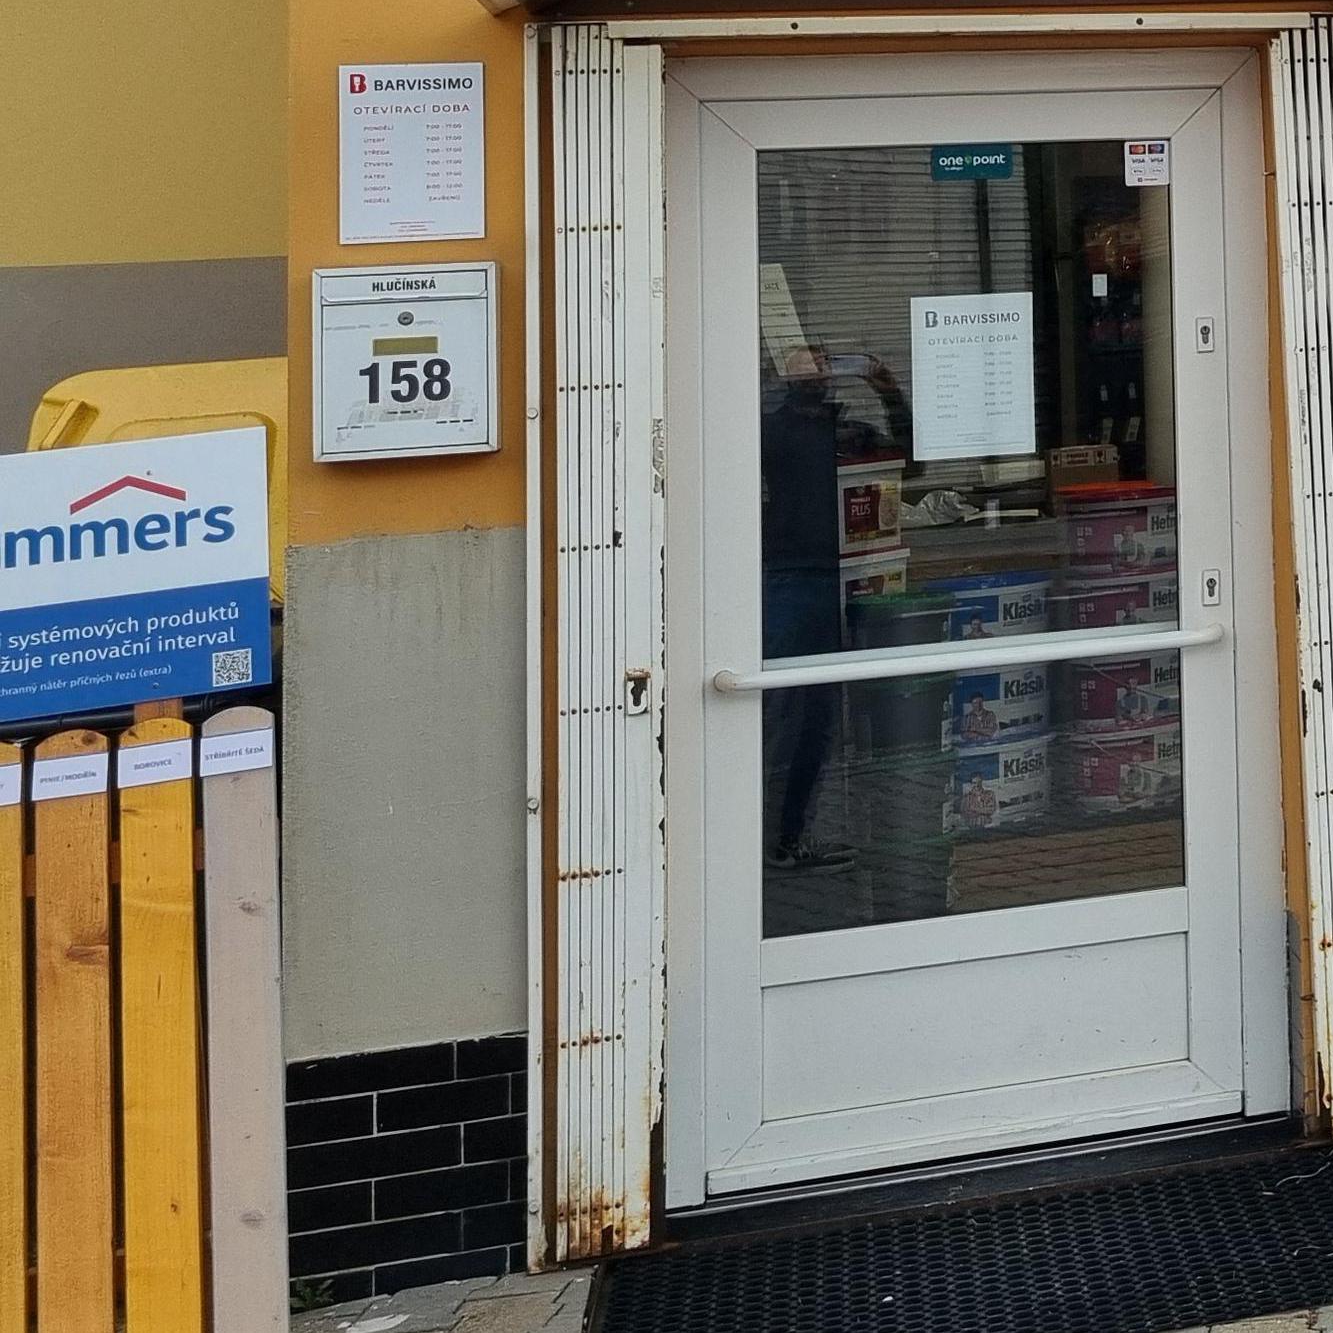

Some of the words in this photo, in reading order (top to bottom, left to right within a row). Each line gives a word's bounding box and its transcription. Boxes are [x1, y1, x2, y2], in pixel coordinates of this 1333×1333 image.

[374, 77, 473, 92] BARVISSIMO
[353, 104, 426, 116] OTEVÍRACÍ
[432, 104, 471, 114] DOBA
[939, 156, 963, 166] one
[973, 153, 1006, 167] point
[372, 276, 437, 292] HLUČÍNSKÁ
[944, 312, 1020, 326] BARVISSIMO
[358, 357, 451, 404] 158
[851, 503, 871, 516] PLUS
[0, 504, 235, 569] mmers
[8, 617, 139, 651] systémových
[147, 601, 239, 634] produktů
[50, 637, 151, 667] renovační
[158, 627, 236, 653] interval
[40, 679, 68, 692] nátěr
[139, 665, 173, 679] (extra)
